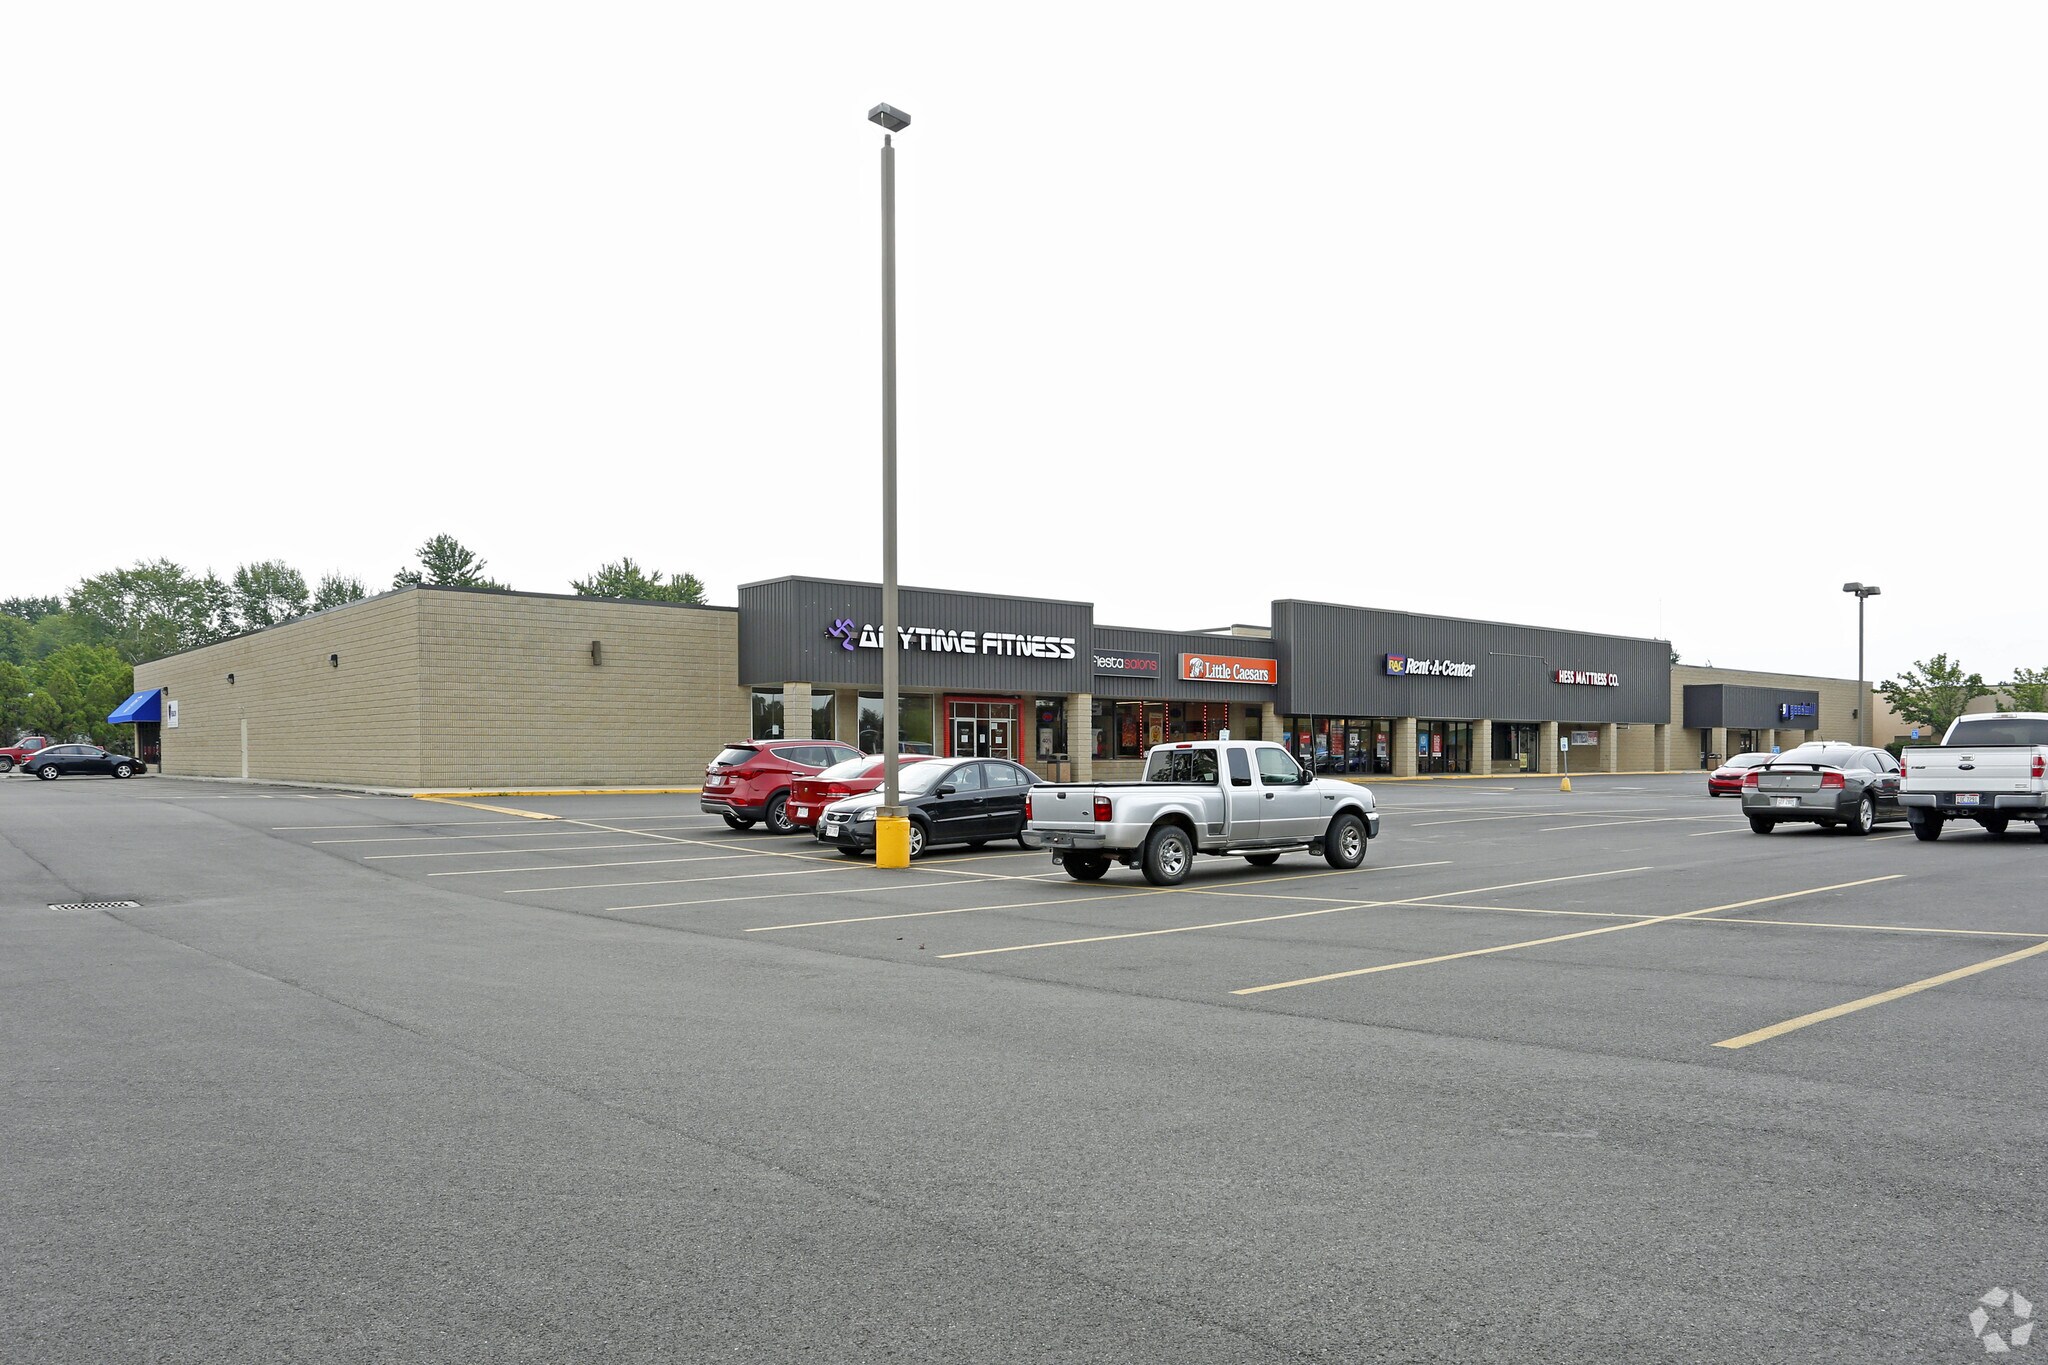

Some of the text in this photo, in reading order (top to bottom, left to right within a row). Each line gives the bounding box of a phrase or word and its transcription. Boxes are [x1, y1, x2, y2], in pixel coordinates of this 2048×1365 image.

[859, 623, 1076, 659] AYTIME FITNESS
[1205, 662, 1269, 681] Little Caesars
[1388, 660, 1404, 672] RAC
[1558, 669, 1620, 687] HESS MATTRESS CO.
